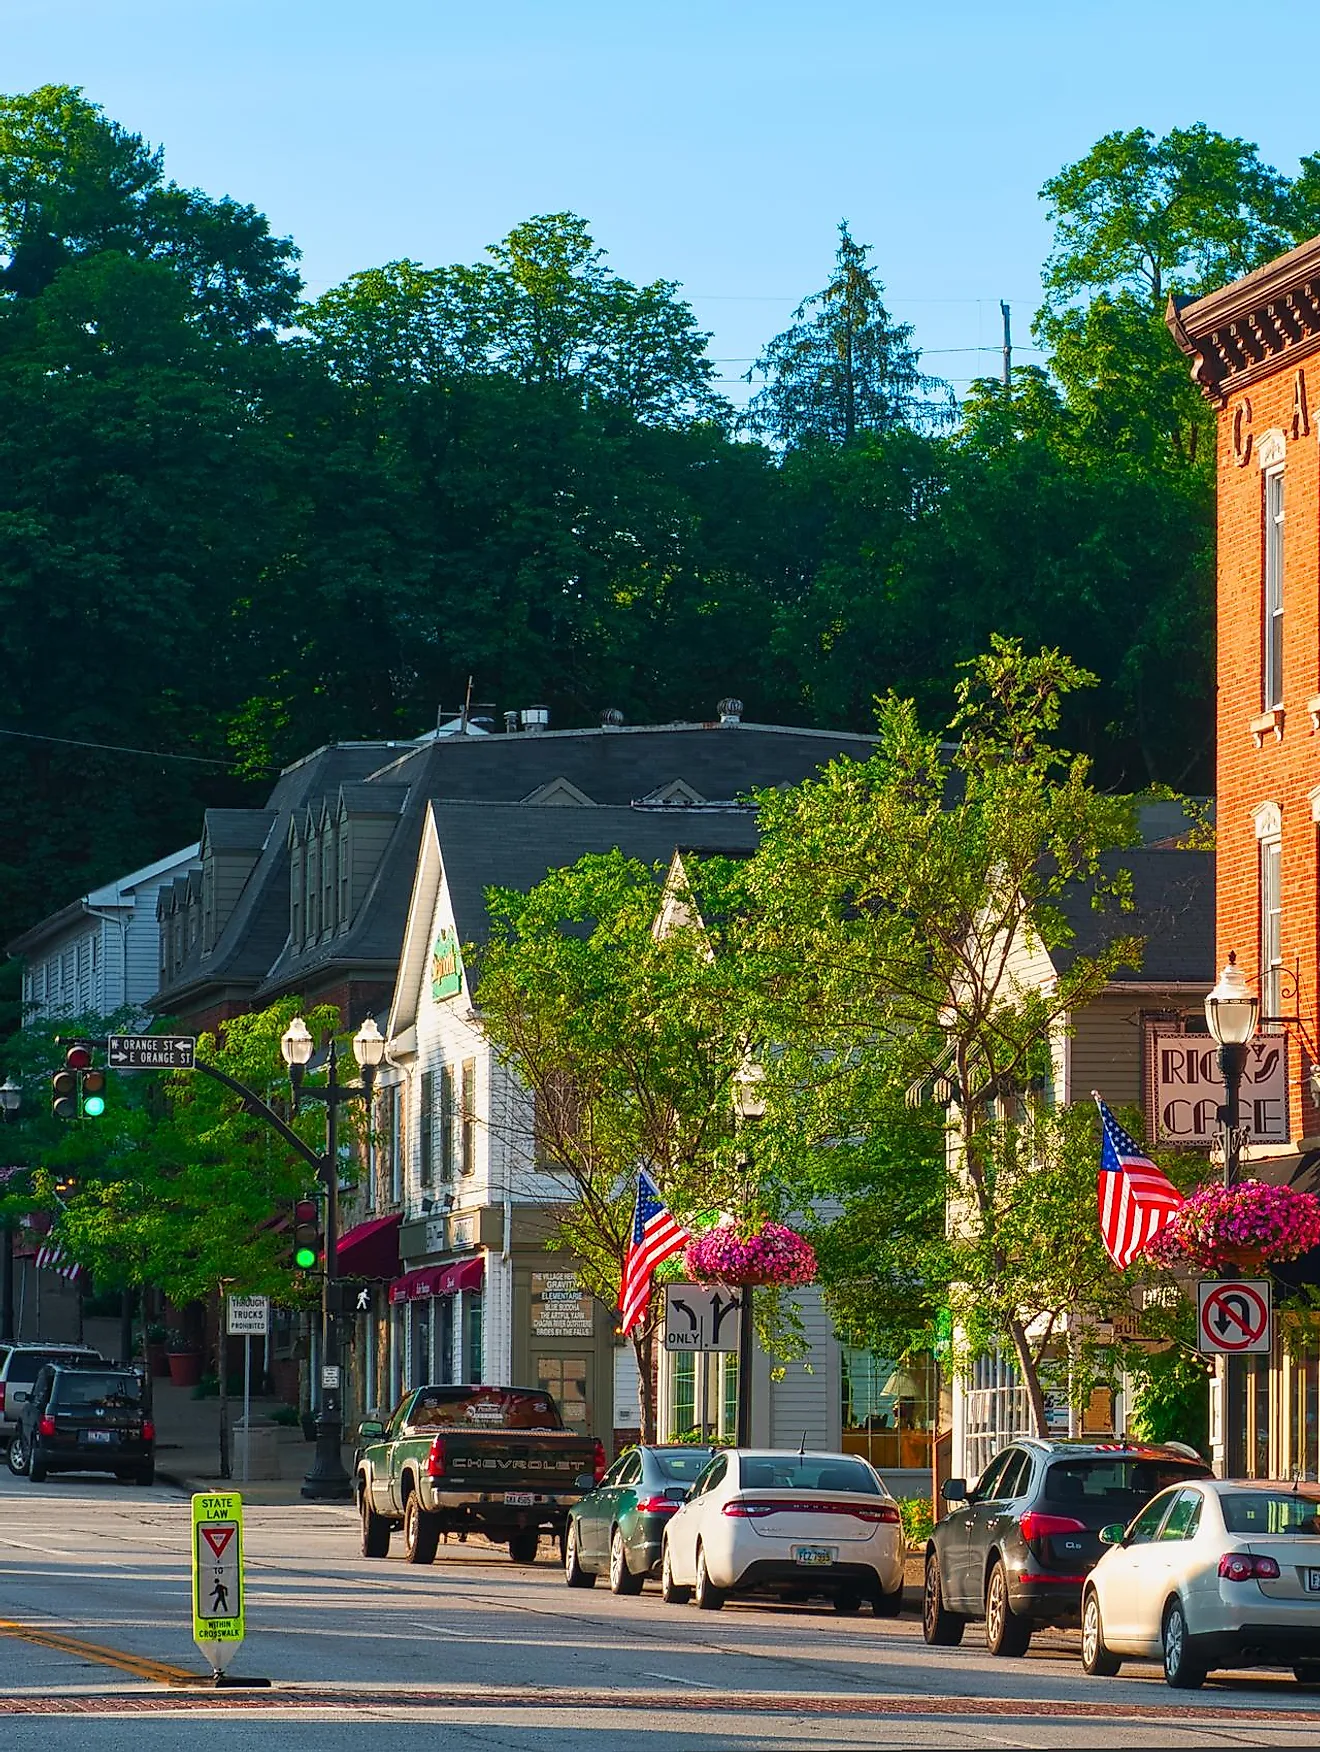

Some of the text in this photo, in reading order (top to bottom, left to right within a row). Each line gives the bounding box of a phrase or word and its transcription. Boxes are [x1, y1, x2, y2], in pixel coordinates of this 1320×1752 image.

[111, 1039, 174, 1051] W ORANGE ST
[129, 1051, 191, 1064] E ORANGE ST
[1162, 1044, 1279, 1084] RIC'S
[543, 1272, 563, 1280] VILLAGE
[546, 1280, 577, 1289] GRAVITY
[544, 1303, 558, 1311] BLUE
[233, 1310, 264, 1319] TRUCKS
[540, 1311, 550, 1319] THE
[668, 1333, 700, 1344] ONLY
[452, 1458, 585, 1471] CHEVROLET
[201, 1498, 233, 1508] STATE
[206, 1509, 229, 1519] LAW
[213, 1566, 224, 1575] TO
[208, 1620, 231, 1629] WITHIN
[198, 1629, 240, 1639] CROSSWALK
